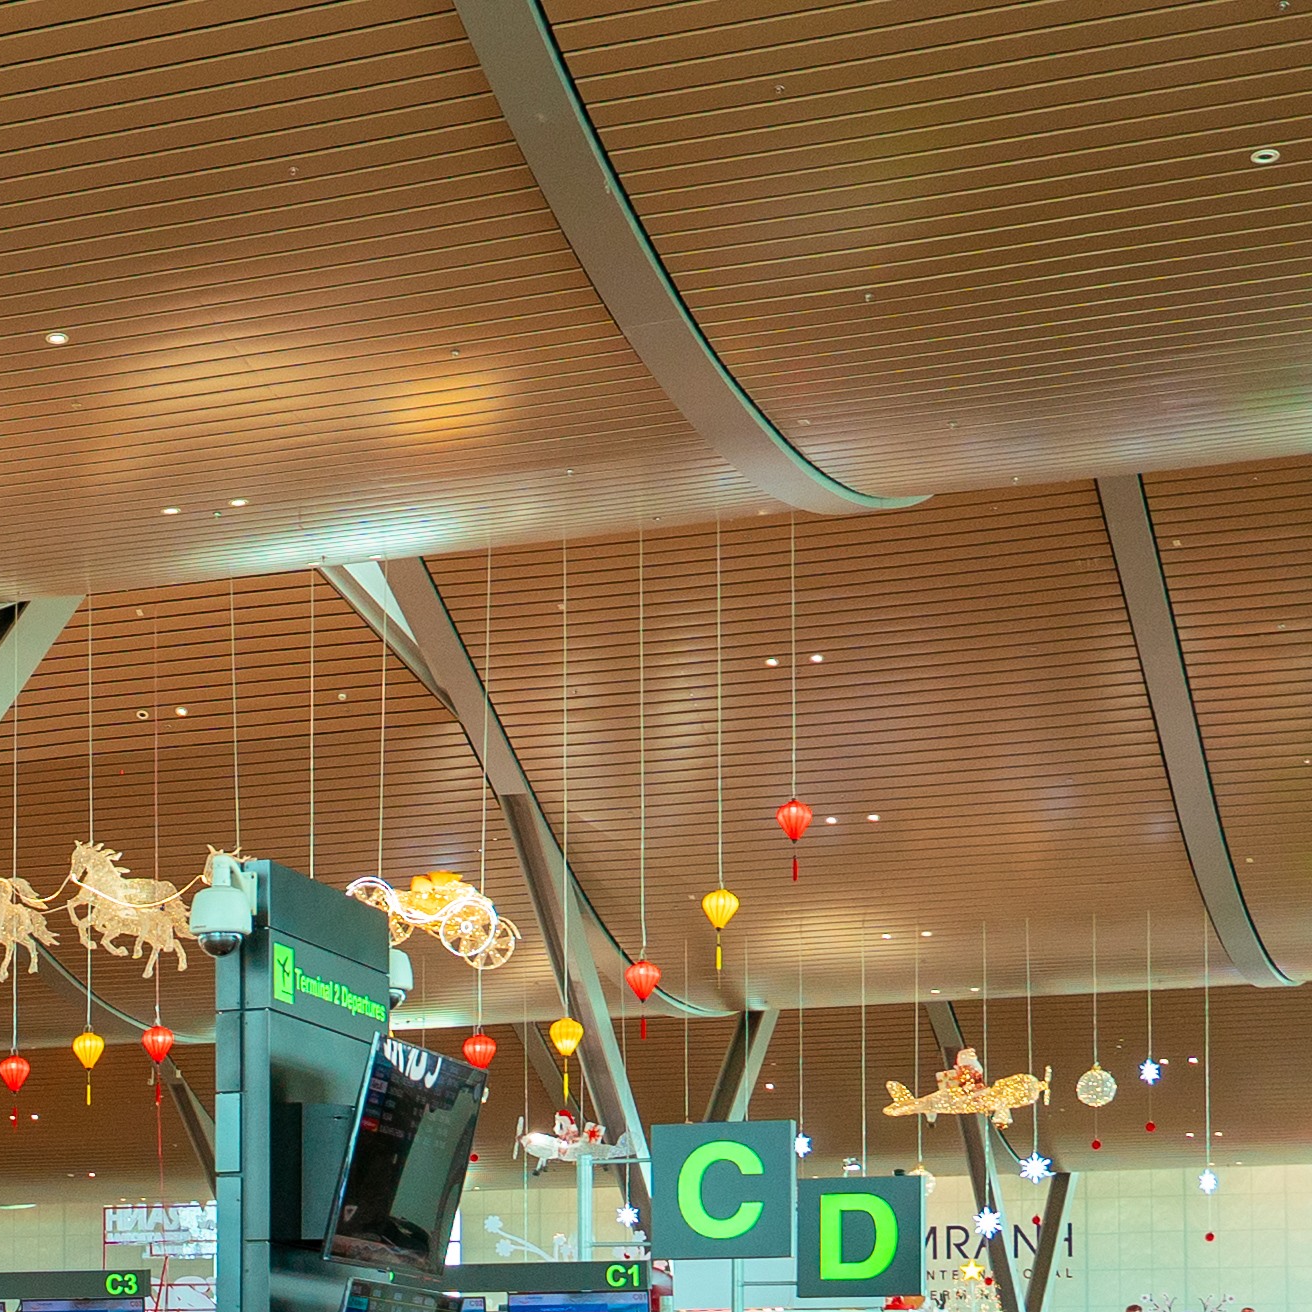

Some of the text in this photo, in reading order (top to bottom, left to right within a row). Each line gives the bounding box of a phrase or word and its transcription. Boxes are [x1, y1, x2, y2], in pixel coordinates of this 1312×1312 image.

[295, 967, 386, 1022] Terminal 2 Departures
[677, 1139, 764, 1239] C
[820, 1193, 898, 1280] D
[105, 1273, 138, 1295] C3
[606, 1264, 640, 1287] C1
